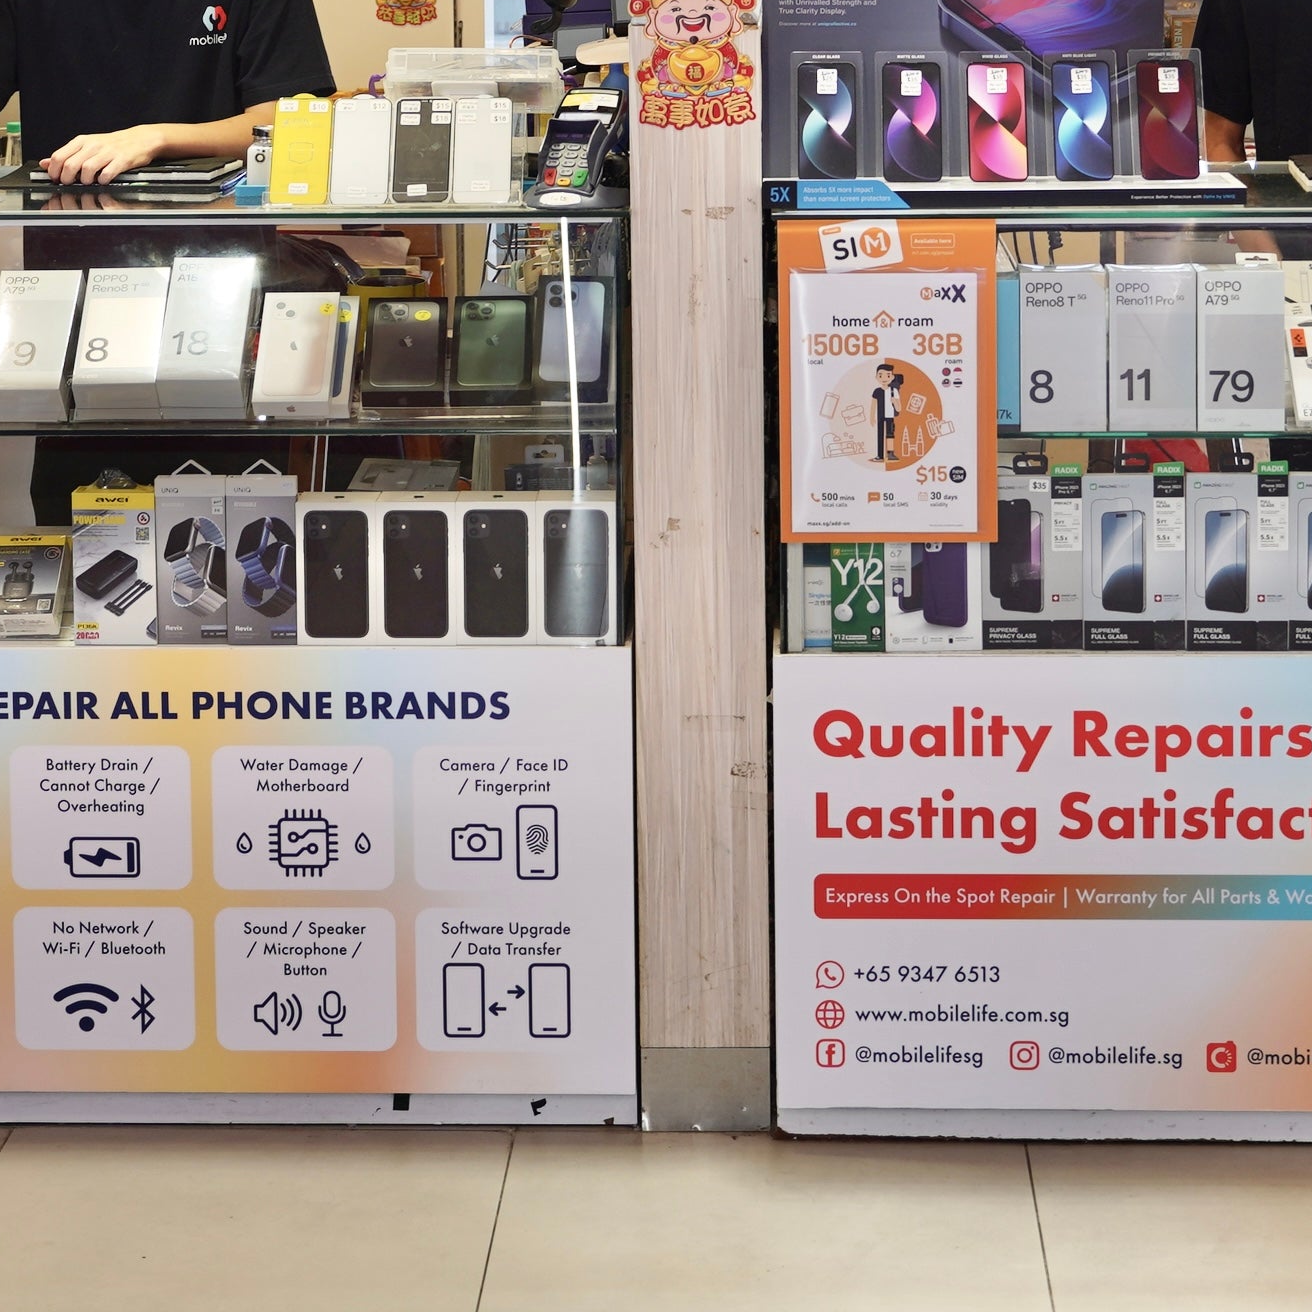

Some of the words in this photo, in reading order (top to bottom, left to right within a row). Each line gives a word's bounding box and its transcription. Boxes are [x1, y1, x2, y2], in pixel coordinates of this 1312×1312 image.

[778, 7, 794, 15] True
[795, 7, 819, 16] Clarity
[820, 7, 846, 16] Display.
[831, 0, 863, 8] Strength
[687, 65, 703, 80] 福
[642, 94, 755, 128] 萬事如意
[770, 187, 790, 203] 5X
[833, 226, 892, 262] SIM
[92, 274, 128, 284] OPPO
[1204, 280, 1242, 293] OPPO
[1025, 282, 1063, 294] OPPO
[1115, 282, 1150, 294] OPPO
[1026, 296, 1064, 308] Reno8
[1116, 295, 1154, 306] Reno11
[1155, 295, 1175, 306] Pro
[1205, 295, 1229, 306] A79
[832, 315, 870, 328] home
[897, 318, 934, 328] roam
[85, 338, 109, 362] 8
[804, 333, 879, 357] 150GB
[912, 333, 964, 356] 3GB
[1029, 369, 1054, 404] 8
[1119, 368, 1151, 401] 11
[1209, 369, 1255, 403] 79
[915, 464, 948, 485] $15
[821, 492, 839, 502] 500
[882, 492, 894, 502] 50
[930, 491, 942, 501] 30
[831, 558, 883, 586] Y12
[110, 691, 178, 720] ALL
[193, 691, 332, 720] PHONE
[345, 690, 510, 720] BRANDS
[813, 706, 1053, 772] Quality
[46, 757, 96, 776] Battery
[100, 757, 139, 772] Drain
[240, 758, 284, 772] Water
[288, 758, 348, 775] Damage
[439, 758, 495, 772] Camera
[516, 758, 549, 772] Face
[553, 758, 569, 772] ID
[39, 778, 91, 793] Cannot
[94, 778, 146, 797] Charge
[256, 778, 350, 793] Motherboard
[474, 778, 551, 796] Fingerprint
[57, 798, 145, 816] Overheating
[815, 789, 1038, 854] Lasting
[825, 887, 890, 907] Express
[894, 887, 921, 904] On
[925, 887, 952, 904] the
[955, 887, 995, 907] Spot
[999, 887, 1056, 907] Repair
[1075, 887, 1158, 909] Warranty
[1162, 887, 1187, 904] for
[1191, 887, 1216, 905] All
[1220, 887, 1263, 905] Parts
[1266, 888, 1281, 905] &
[53, 920, 75, 935] No
[78, 920, 140, 935] Network
[243, 921, 288, 935] Sound
[308, 921, 366, 939] Speaker
[441, 921, 504, 936] Software
[508, 921, 571, 939] Upgrade
[42, 941, 81, 955] Wi-Fi
[100, 941, 166, 955] Bluetooth
[263, 942, 348, 959] Microphone
[467, 942, 501, 956] Data
[505, 941, 562, 956] Transfer
[283, 963, 328, 977] Button
[853, 965, 890, 983] +65
[897, 965, 948, 983] 9347
[953, 965, 1001, 983] 6513
[855, 1005, 1070, 1027] www.mobilelife.com.sg
[855, 1045, 984, 1069] @mobilelifesg
[1048, 1046, 1183, 1070] @mobilelife.sg
